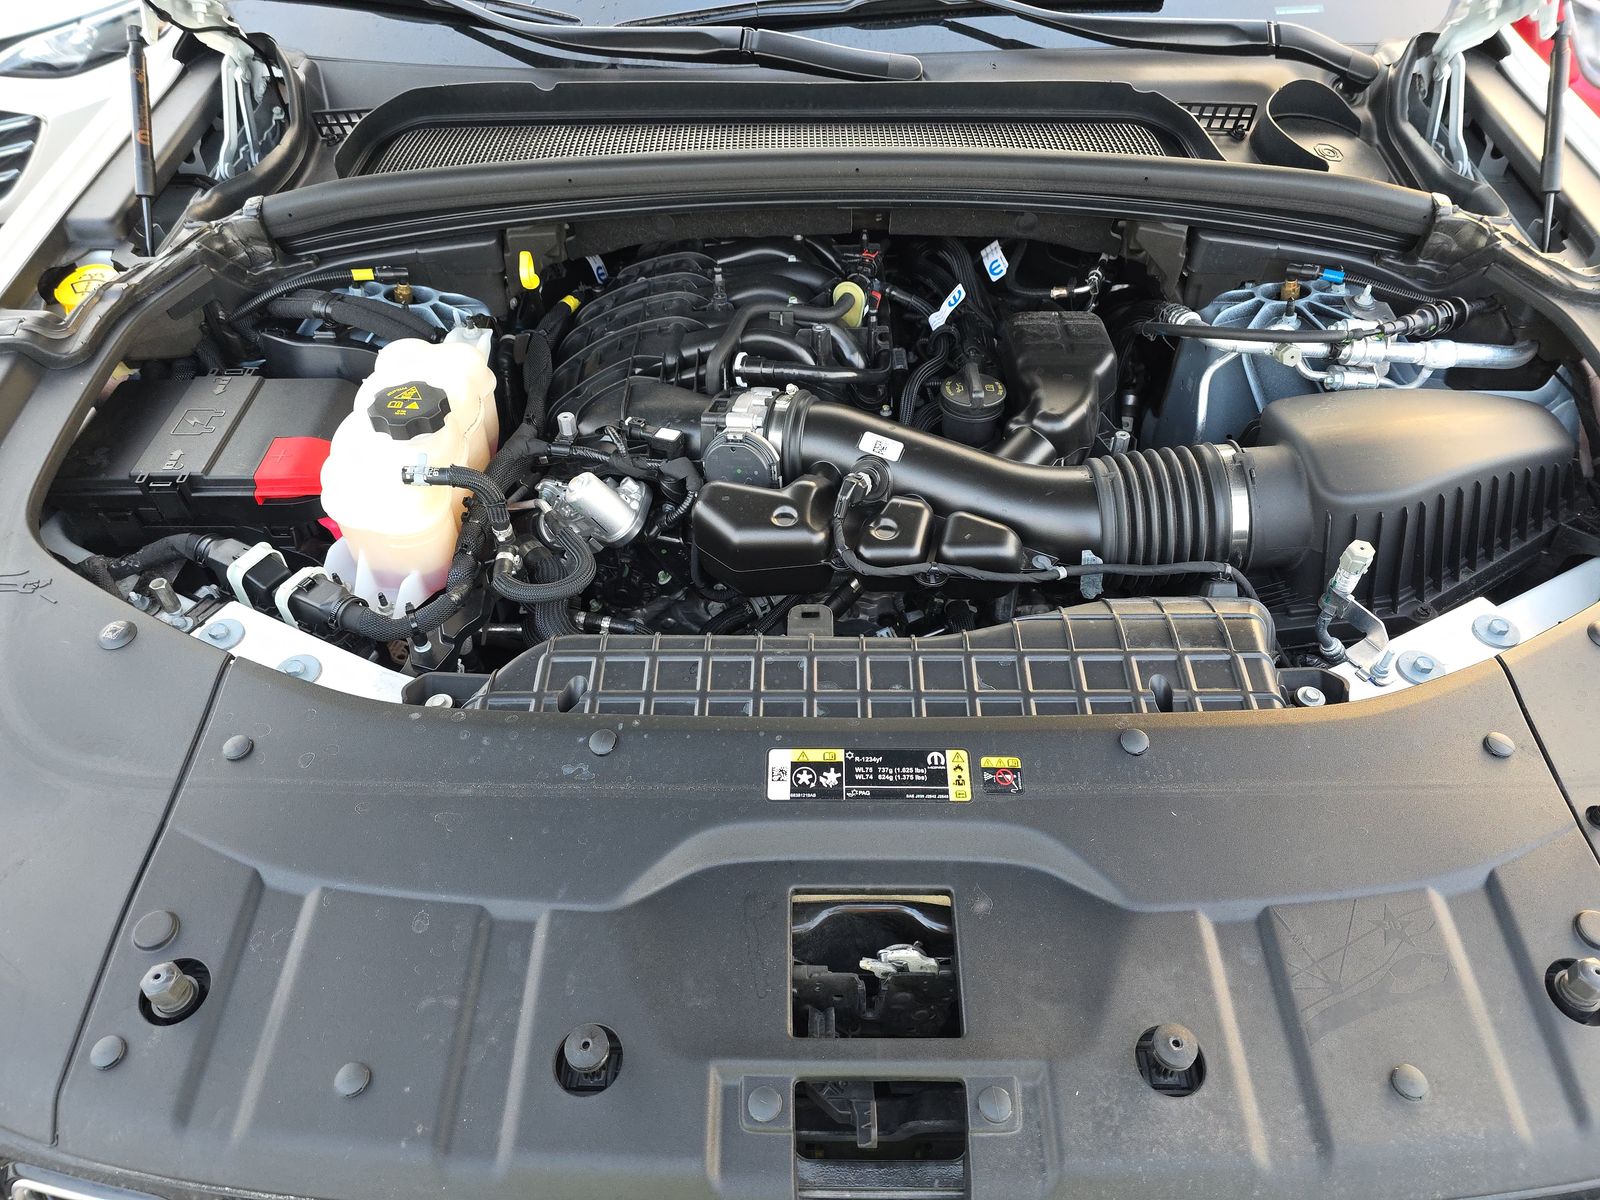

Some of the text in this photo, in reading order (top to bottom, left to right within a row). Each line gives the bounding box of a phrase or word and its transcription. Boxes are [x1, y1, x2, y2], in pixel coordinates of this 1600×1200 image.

[854, 756, 883, 764] R-1234yf
[877, 766, 893, 775] 737g
[894, 766, 914, 775] (1.625
[914, 766, 928, 775] lbs)
[877, 774, 894, 782] 624g
[894, 774, 915, 782] (1.375
[914, 774, 928, 782] lbs)
